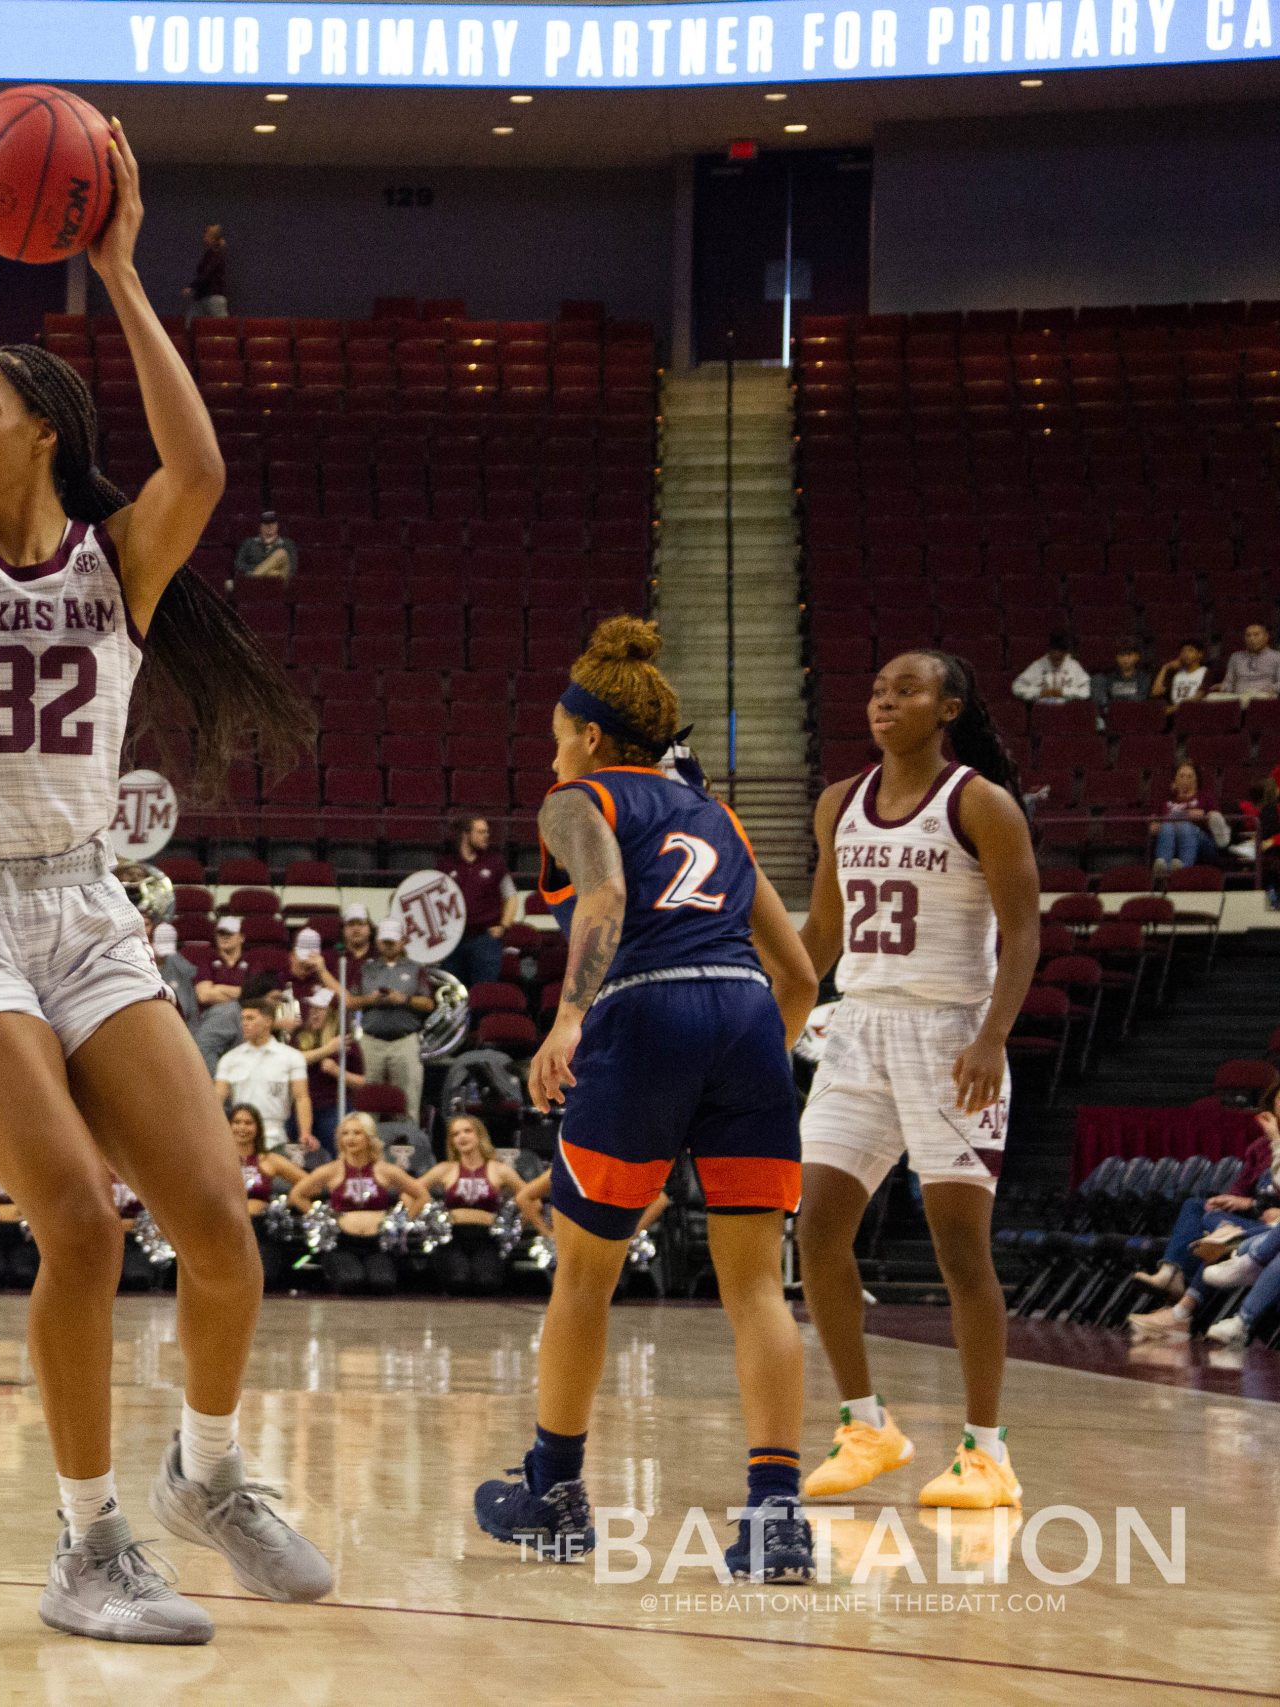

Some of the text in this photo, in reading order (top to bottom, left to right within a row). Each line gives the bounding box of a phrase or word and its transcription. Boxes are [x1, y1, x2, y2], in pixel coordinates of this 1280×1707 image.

[130, 16, 260, 74] YOUR
[287, 17, 518, 77] PRIMARY
[545, 15, 774, 77] PARTNER
[802, 10, 898, 71] FOR
[927, 0, 1174, 65] PRIMARY
[52, 177, 91, 249] NCAA
[74, 553, 97, 573] SEC
[63, 597, 116, 632] A&M
[652, 831, 727, 912] 2
[898, 849, 949, 873] A&M
[846, 879, 919, 956] 23
